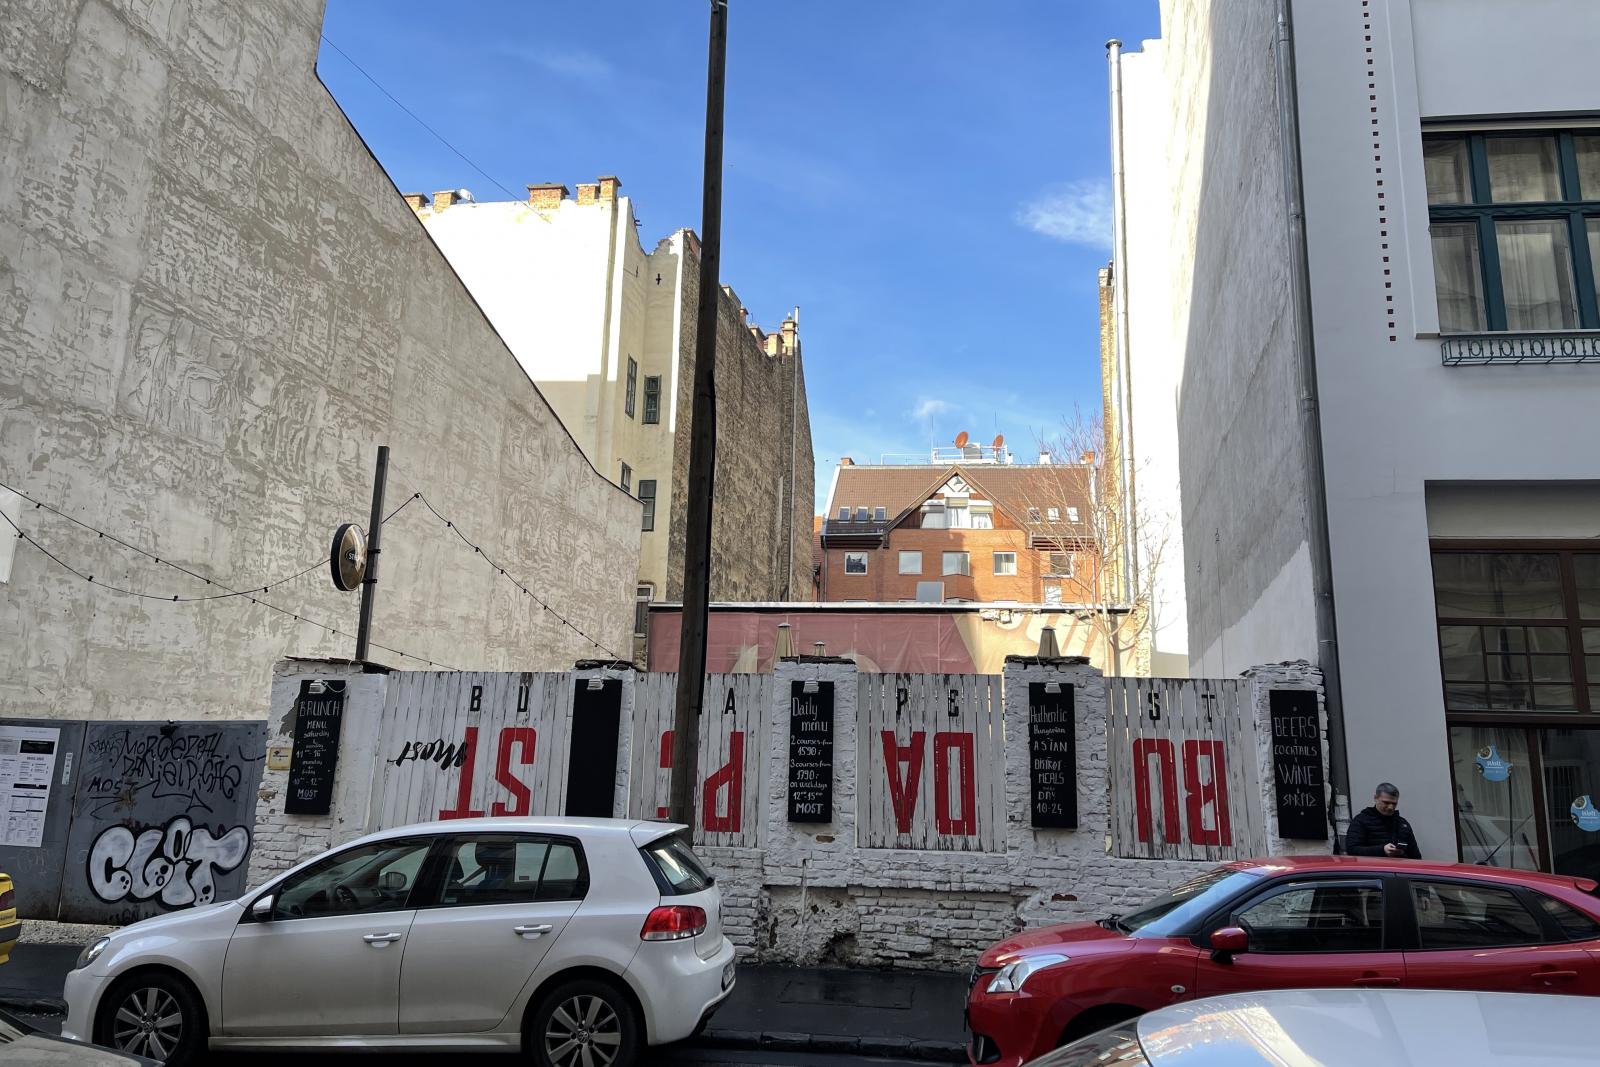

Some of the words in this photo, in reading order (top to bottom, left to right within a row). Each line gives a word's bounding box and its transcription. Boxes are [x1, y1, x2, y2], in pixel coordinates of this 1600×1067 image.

[299, 700, 341, 717] BRUNCH
[792, 696, 818, 721] Daily
[1029, 703, 1068, 723] Authentic
[306, 720, 328, 729] MENU
[801, 721, 828, 732] menu
[1273, 715, 1318, 739] BEERS
[791, 735, 796, 745] 2
[1274, 745, 1318, 756] COCKTAILS
[790, 758, 795, 768] 3
[1038, 772, 1065, 785] MEALS
[297, 788, 319, 798] MOST
[1038, 791, 1056, 801] DAY
[795, 803, 824, 815] MOST
